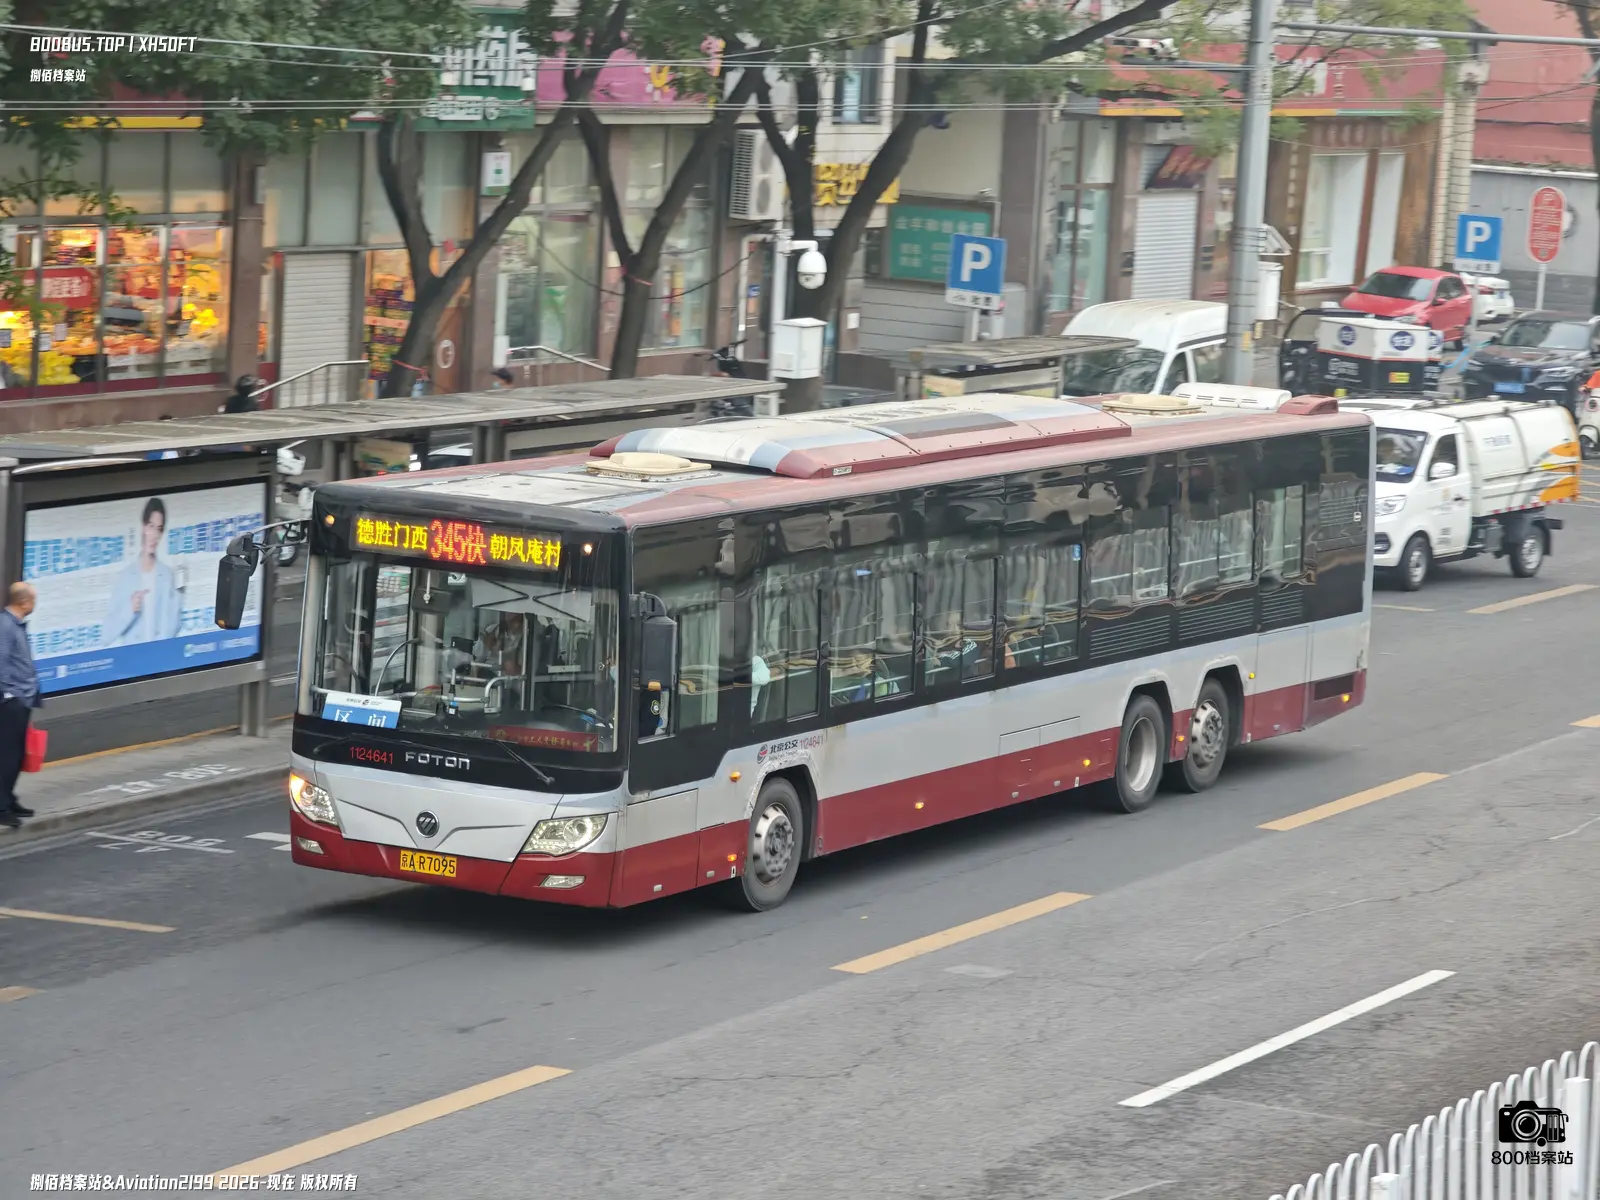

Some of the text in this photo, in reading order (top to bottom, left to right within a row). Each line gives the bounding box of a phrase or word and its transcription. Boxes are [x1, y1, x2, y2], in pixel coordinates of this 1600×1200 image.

[1465, 220, 1491, 253] P
[960, 242, 992, 282] P
[356, 517, 561, 567] 德胜门西 345快 朝凤庵村
[334, 708, 387, 728] 区间
[350, 747, 394, 765] 1124641
[769, 739, 798, 755] 北京公交
[405, 751, 471, 770] FOTON
